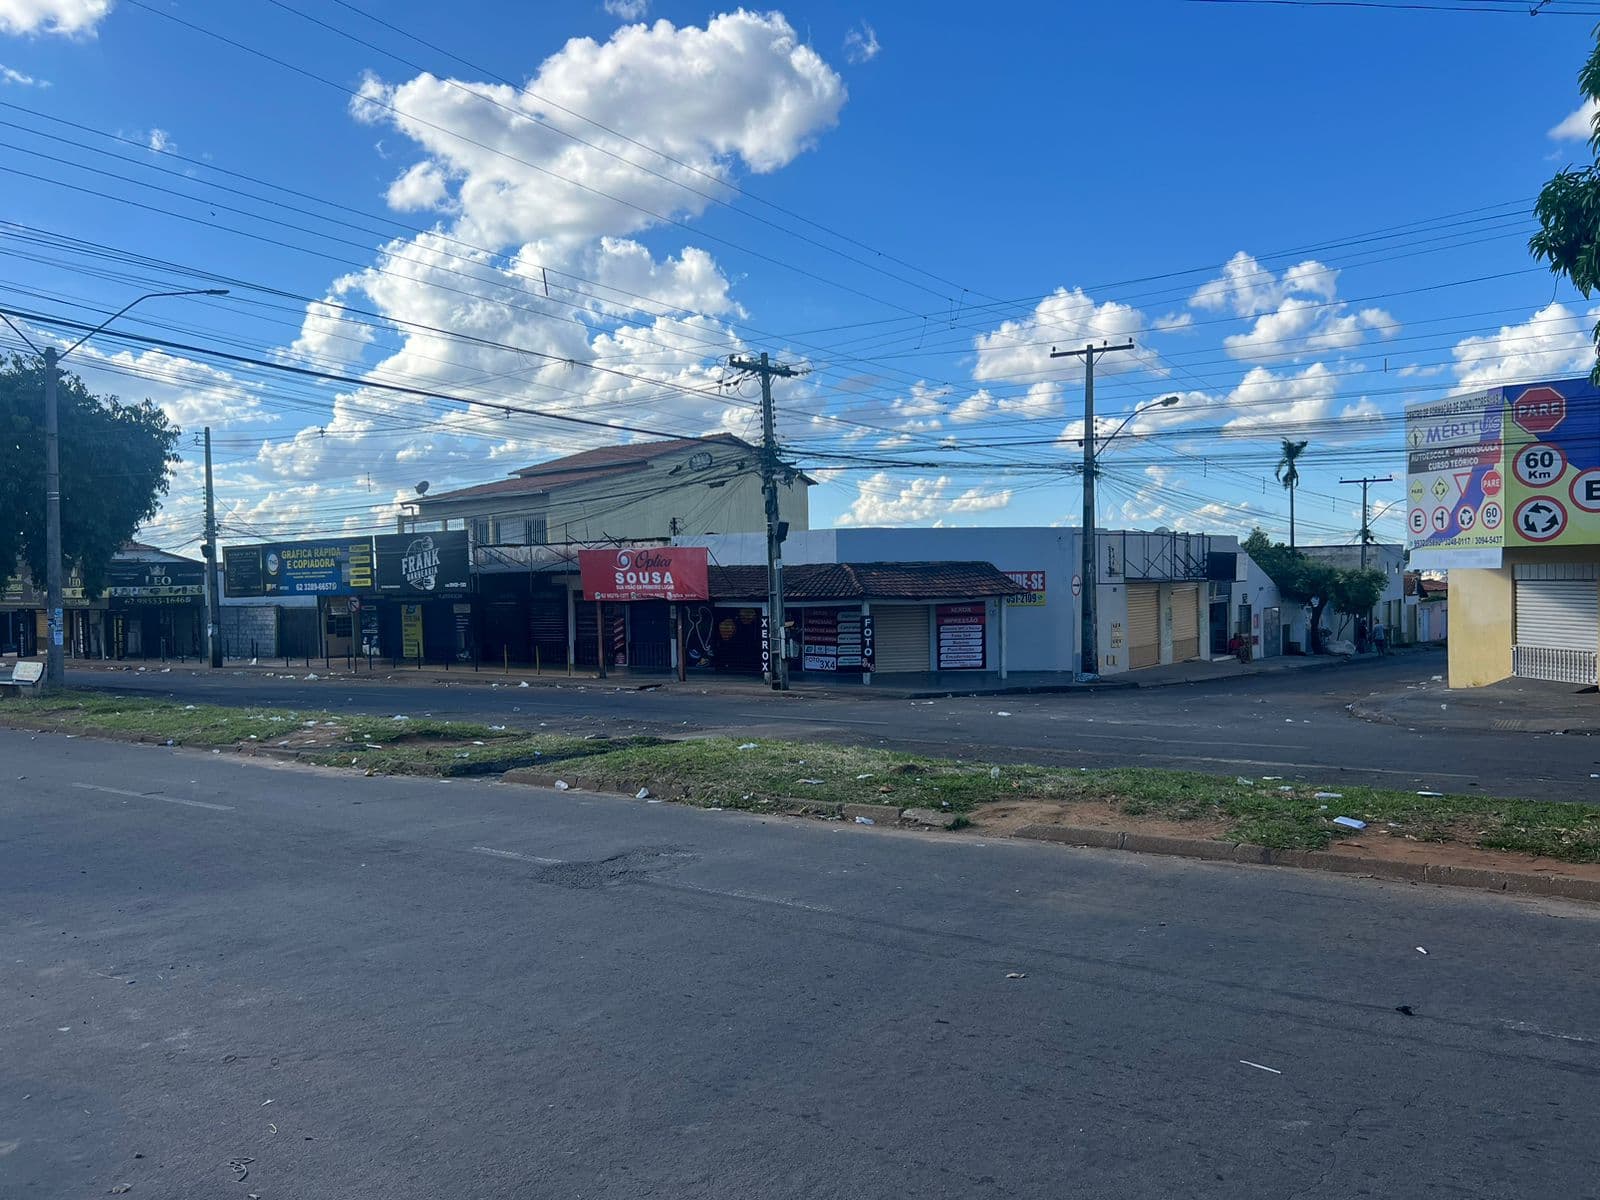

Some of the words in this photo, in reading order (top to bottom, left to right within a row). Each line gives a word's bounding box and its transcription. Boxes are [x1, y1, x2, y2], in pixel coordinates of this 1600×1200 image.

[1518, 402, 1561, 418] PARE
[1427, 416, 1502, 443] MÉRITUS
[1411, 449, 1449, 462] AUTOESCOLA
[1455, 444, 1500, 457] MOTOESCOLA
[1525, 451, 1554, 469] 60
[1428, 461, 1450, 472] CURSO
[1451, 456, 1479, 468] TEÓRICO
[1528, 470, 1550, 479] Km
[1483, 478, 1501, 488] PARE
[1486, 507, 1498, 518] 60
[1414, 515, 1421, 527] E
[287, 560, 292, 569] E
[293, 558, 336, 569] COPIADORA
[402, 548, 441, 575] FRANK
[615, 572, 674, 584] SOUSA
[761, 618, 769, 671] XEROX
[864, 618, 872, 656] FOTO
[820, 660, 836, 670] 3X4
